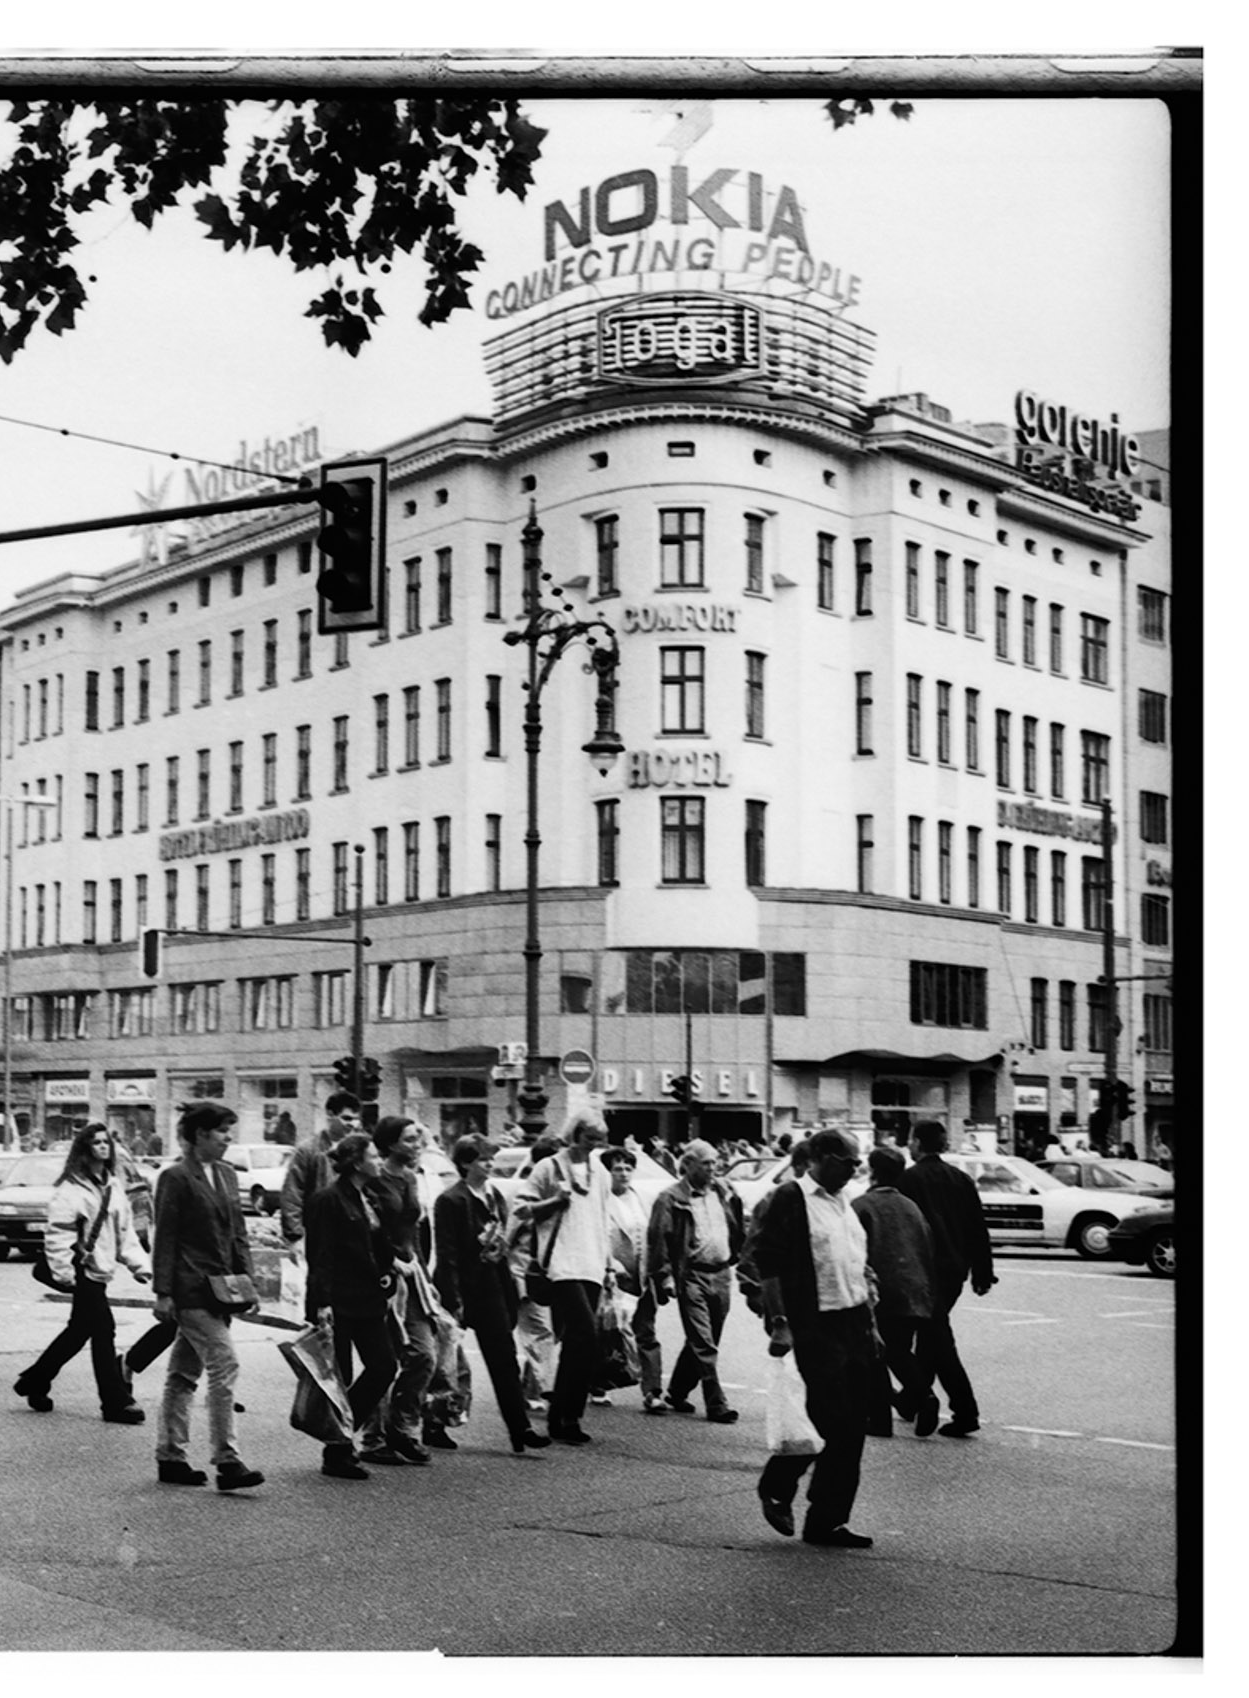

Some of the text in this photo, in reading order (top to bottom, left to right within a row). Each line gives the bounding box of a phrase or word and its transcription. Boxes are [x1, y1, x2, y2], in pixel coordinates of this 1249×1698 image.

[545, 165, 809, 261] NOKIA
[485, 238, 862, 320] CONNECTING PEOPLE
[184, 425, 322, 502] Nordstern
[624, 604, 740, 634] COMFORT
[626, 748, 732, 789] HOTEL
[604, 1069, 758, 1097] DIESEL
